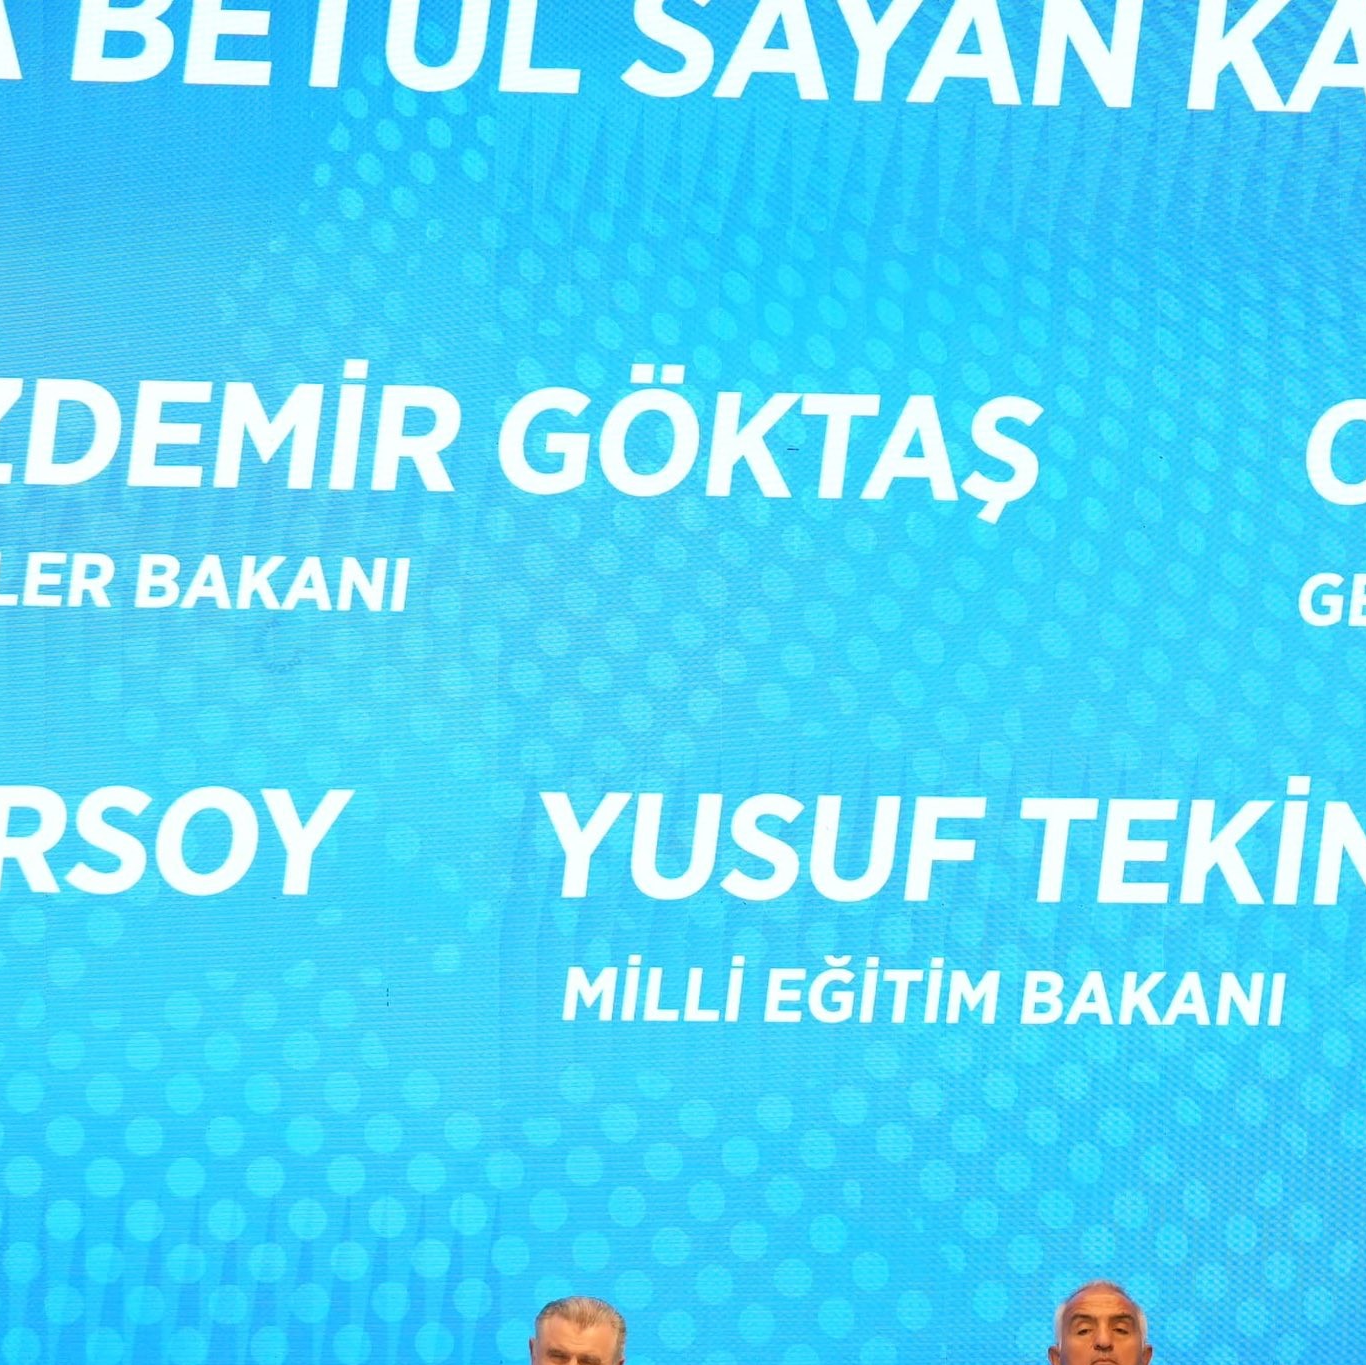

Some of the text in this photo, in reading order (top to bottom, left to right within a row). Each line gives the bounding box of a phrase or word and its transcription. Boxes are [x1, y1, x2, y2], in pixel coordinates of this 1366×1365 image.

[621, 0, 1144, 108] SAYAN
[498, 363, 1044, 524] GÖKTAŞ
[134, 553, 411, 612] BAKANI
[540, 791, 987, 903] YUSUF
[562, 954, 1287, 1026] MİLLİ EĞİTİM BAKANI
